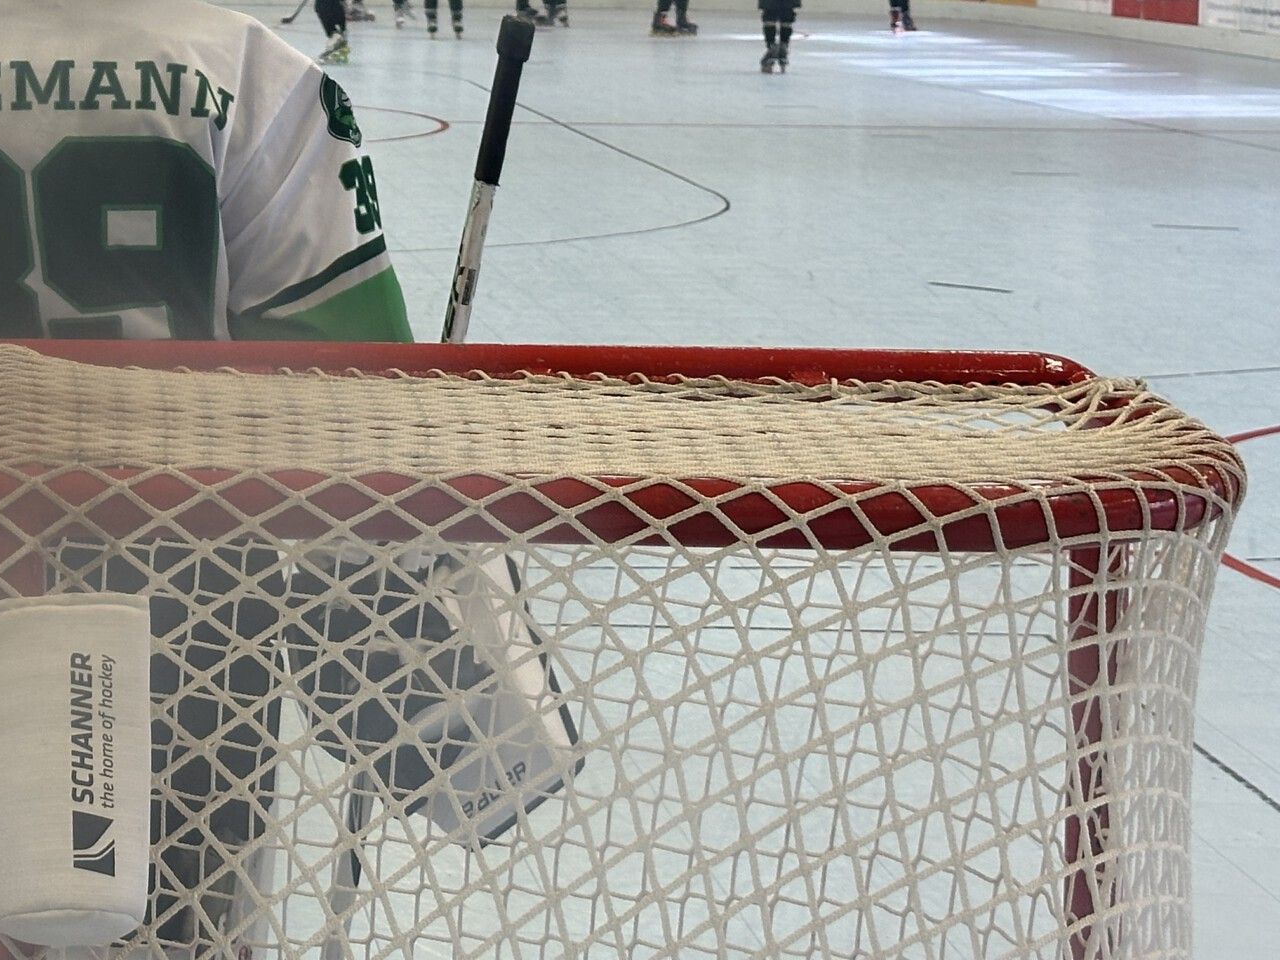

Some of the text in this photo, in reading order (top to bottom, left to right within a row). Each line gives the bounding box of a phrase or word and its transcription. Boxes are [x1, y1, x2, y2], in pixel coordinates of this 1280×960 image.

[70, 652, 94, 805] SCHANNER
[98, 654, 116, 809] the home of hockey
